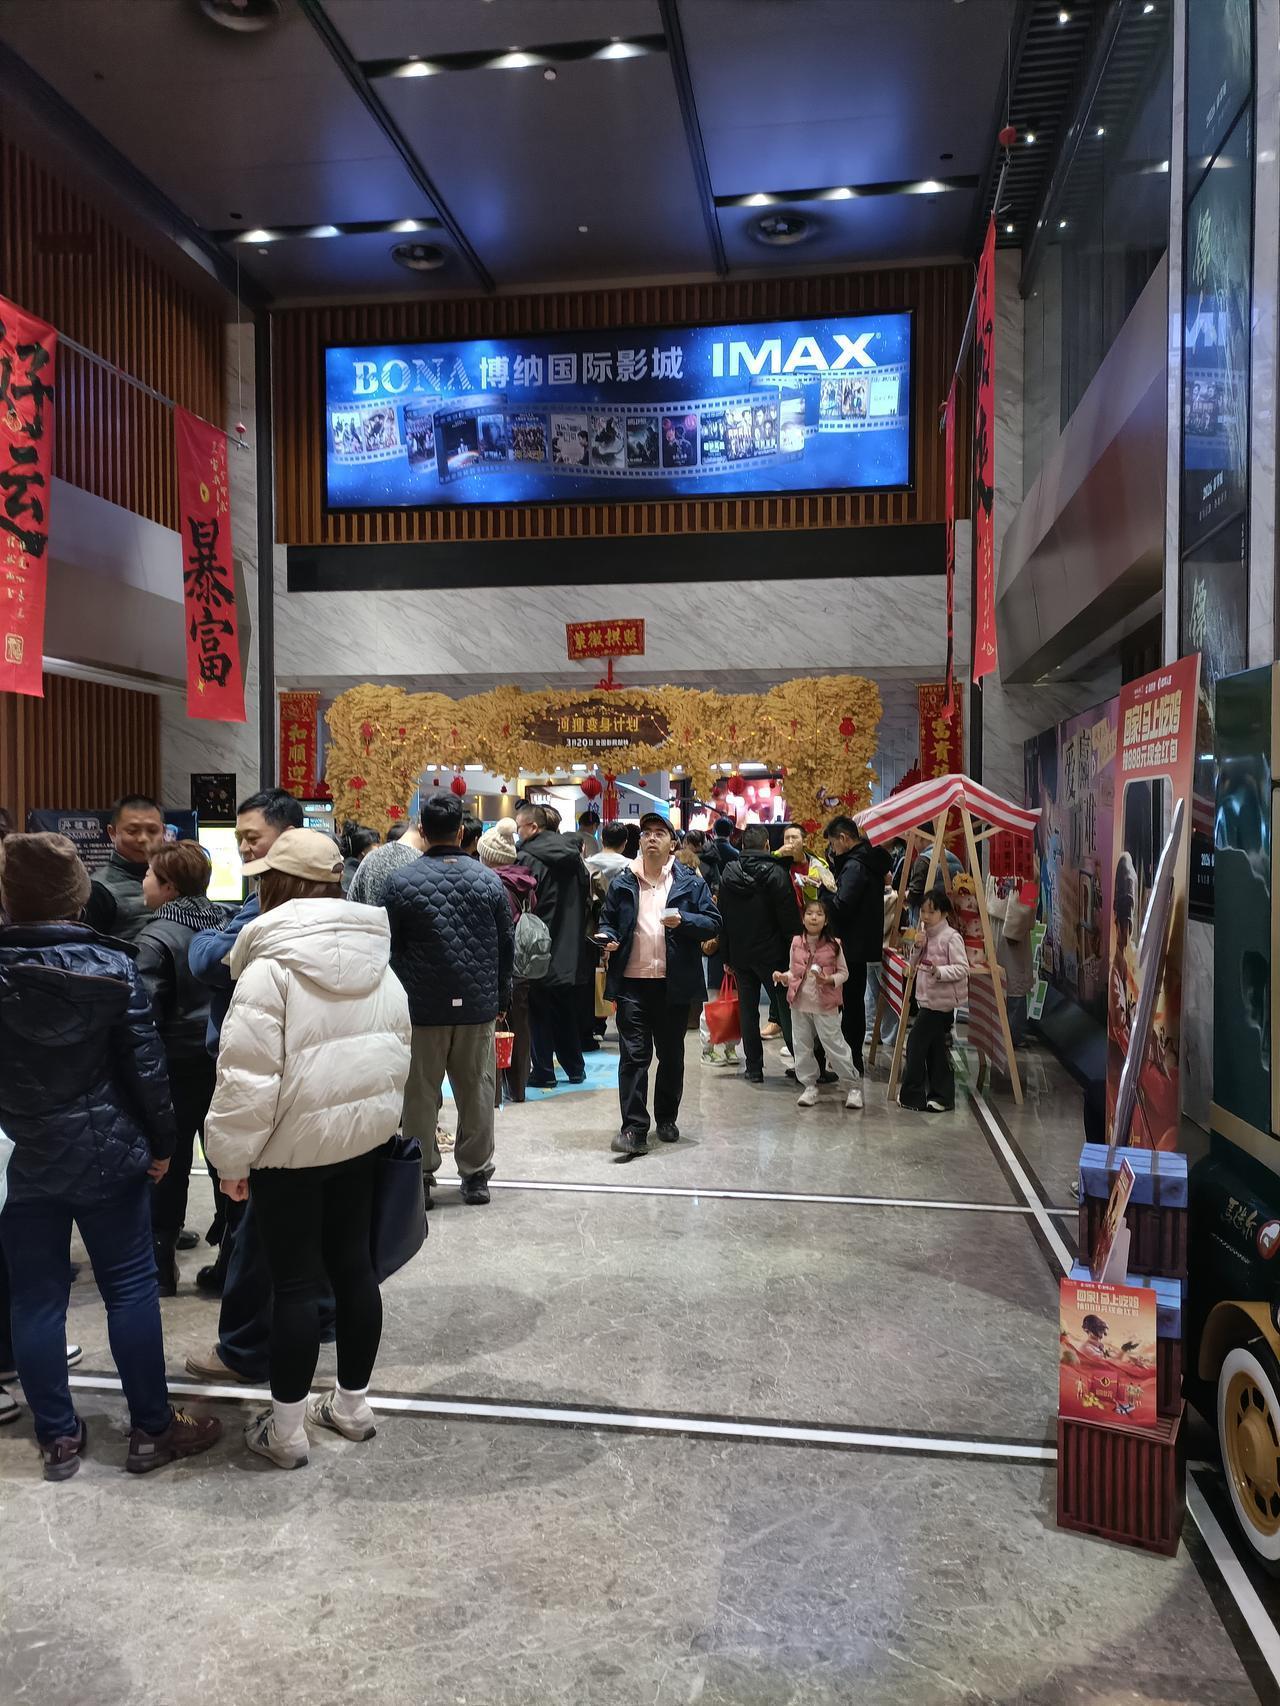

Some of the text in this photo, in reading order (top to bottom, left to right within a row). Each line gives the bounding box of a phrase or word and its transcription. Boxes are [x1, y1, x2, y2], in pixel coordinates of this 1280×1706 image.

[352, 356, 474, 394] BONA
[479, 346, 684, 390] 博纳国际影城
[712, 332, 877, 377] IMAX
[183, 516, 235, 687] 暴富
[558, 715, 640, 733] 河狸变身计划
